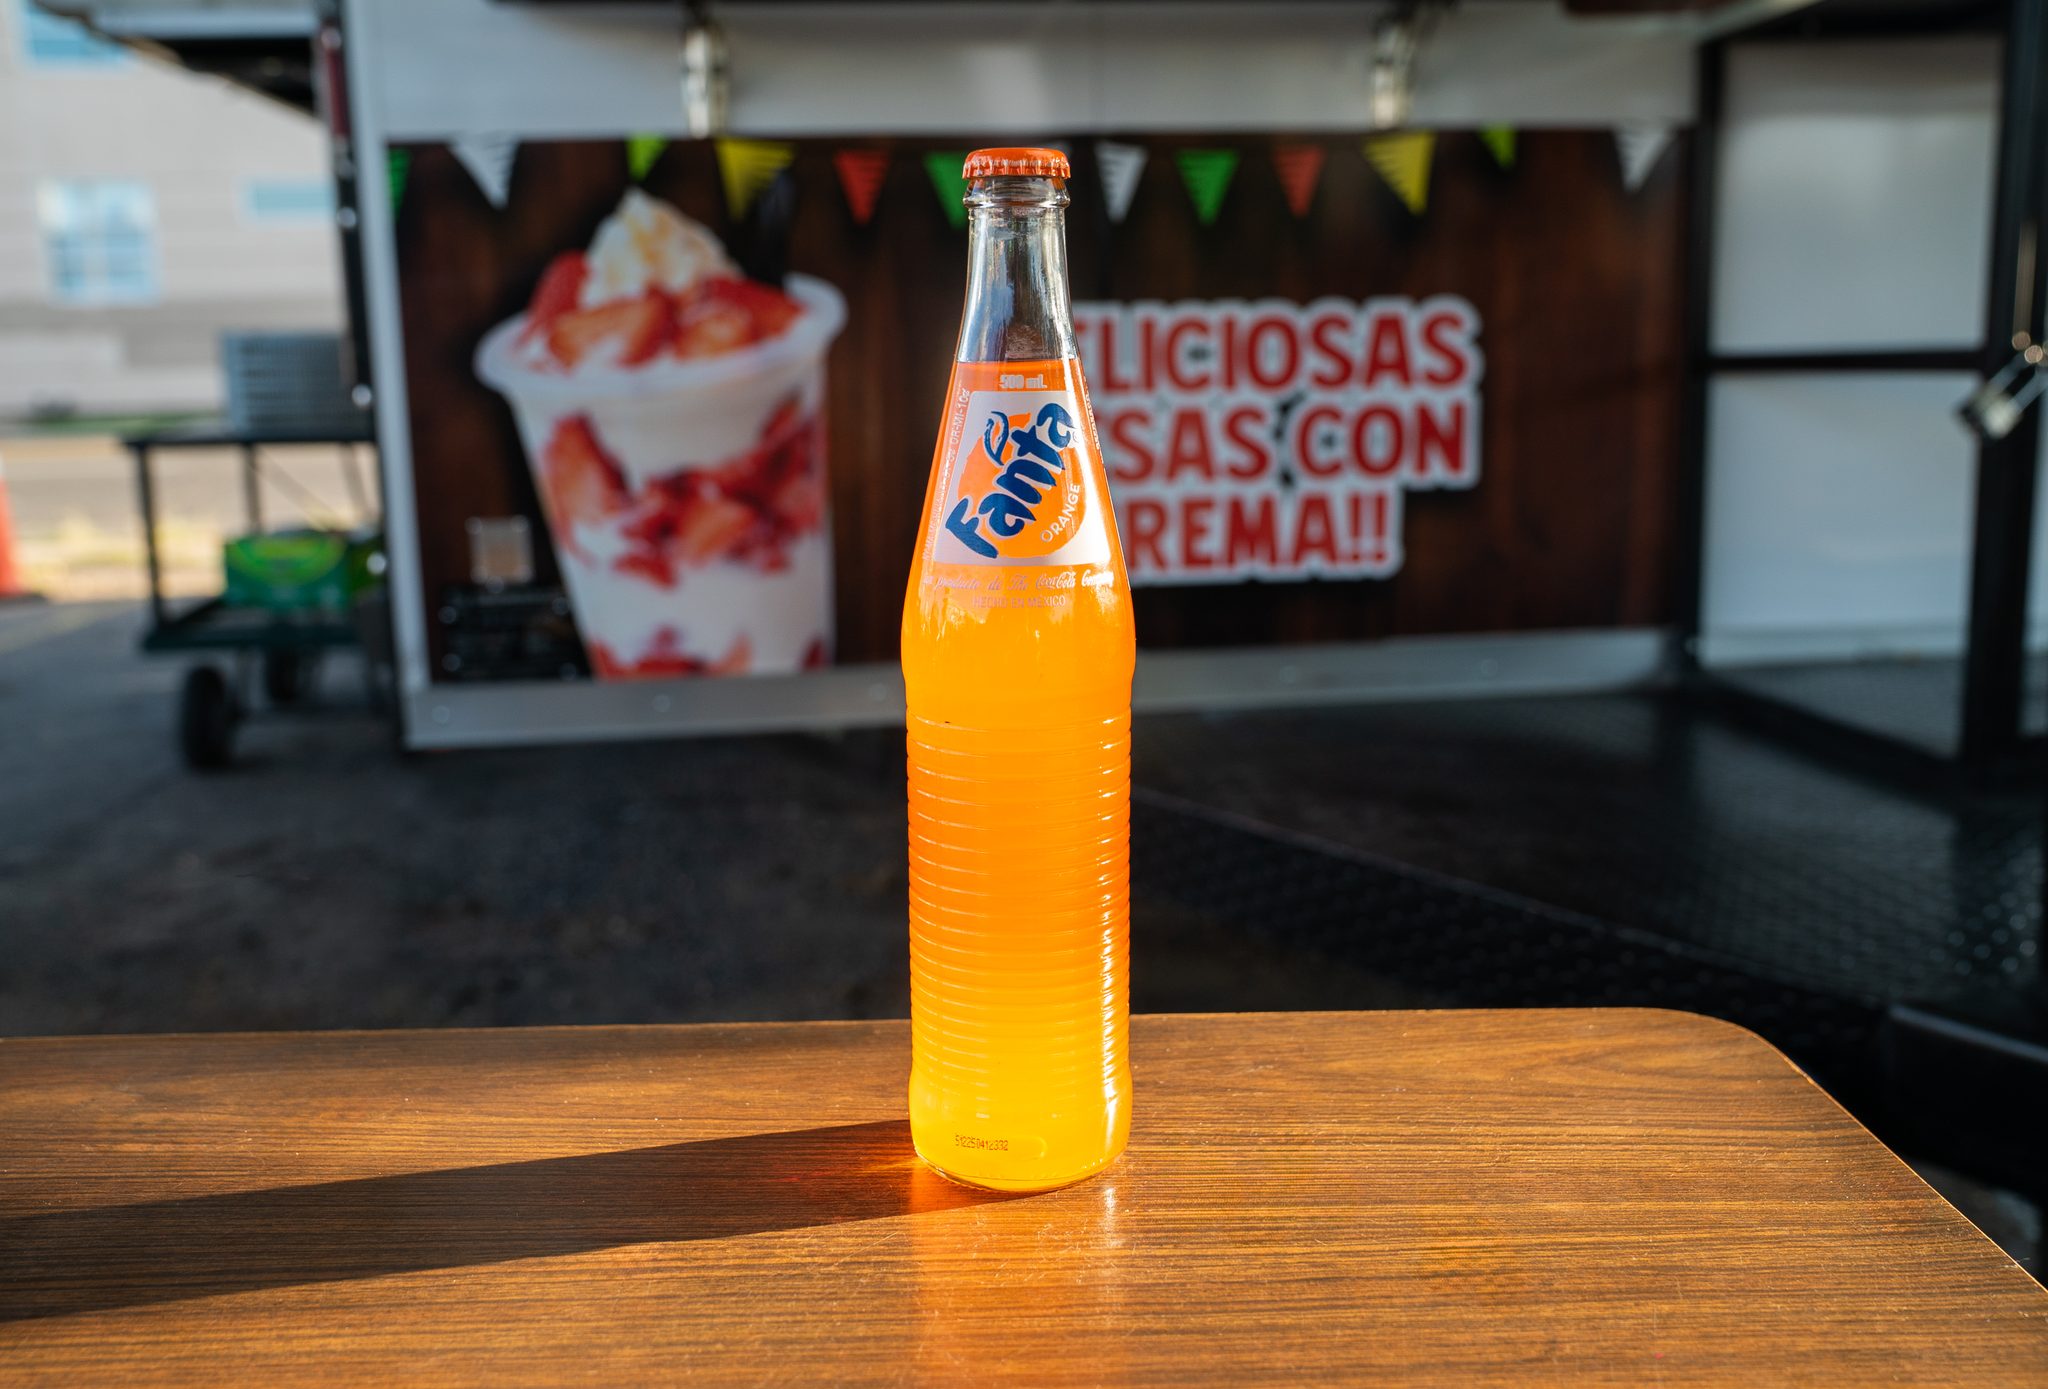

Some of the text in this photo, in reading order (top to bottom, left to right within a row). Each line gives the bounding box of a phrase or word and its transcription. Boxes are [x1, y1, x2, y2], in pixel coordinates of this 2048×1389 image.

[1298, 402, 1468, 477] CON
[945, 402, 1076, 559] Fanta
[1040, 483, 1081, 543] ORANGE
[1123, 490, 1388, 571] REMA!!
[972, 596, 1008, 608] HECHO
